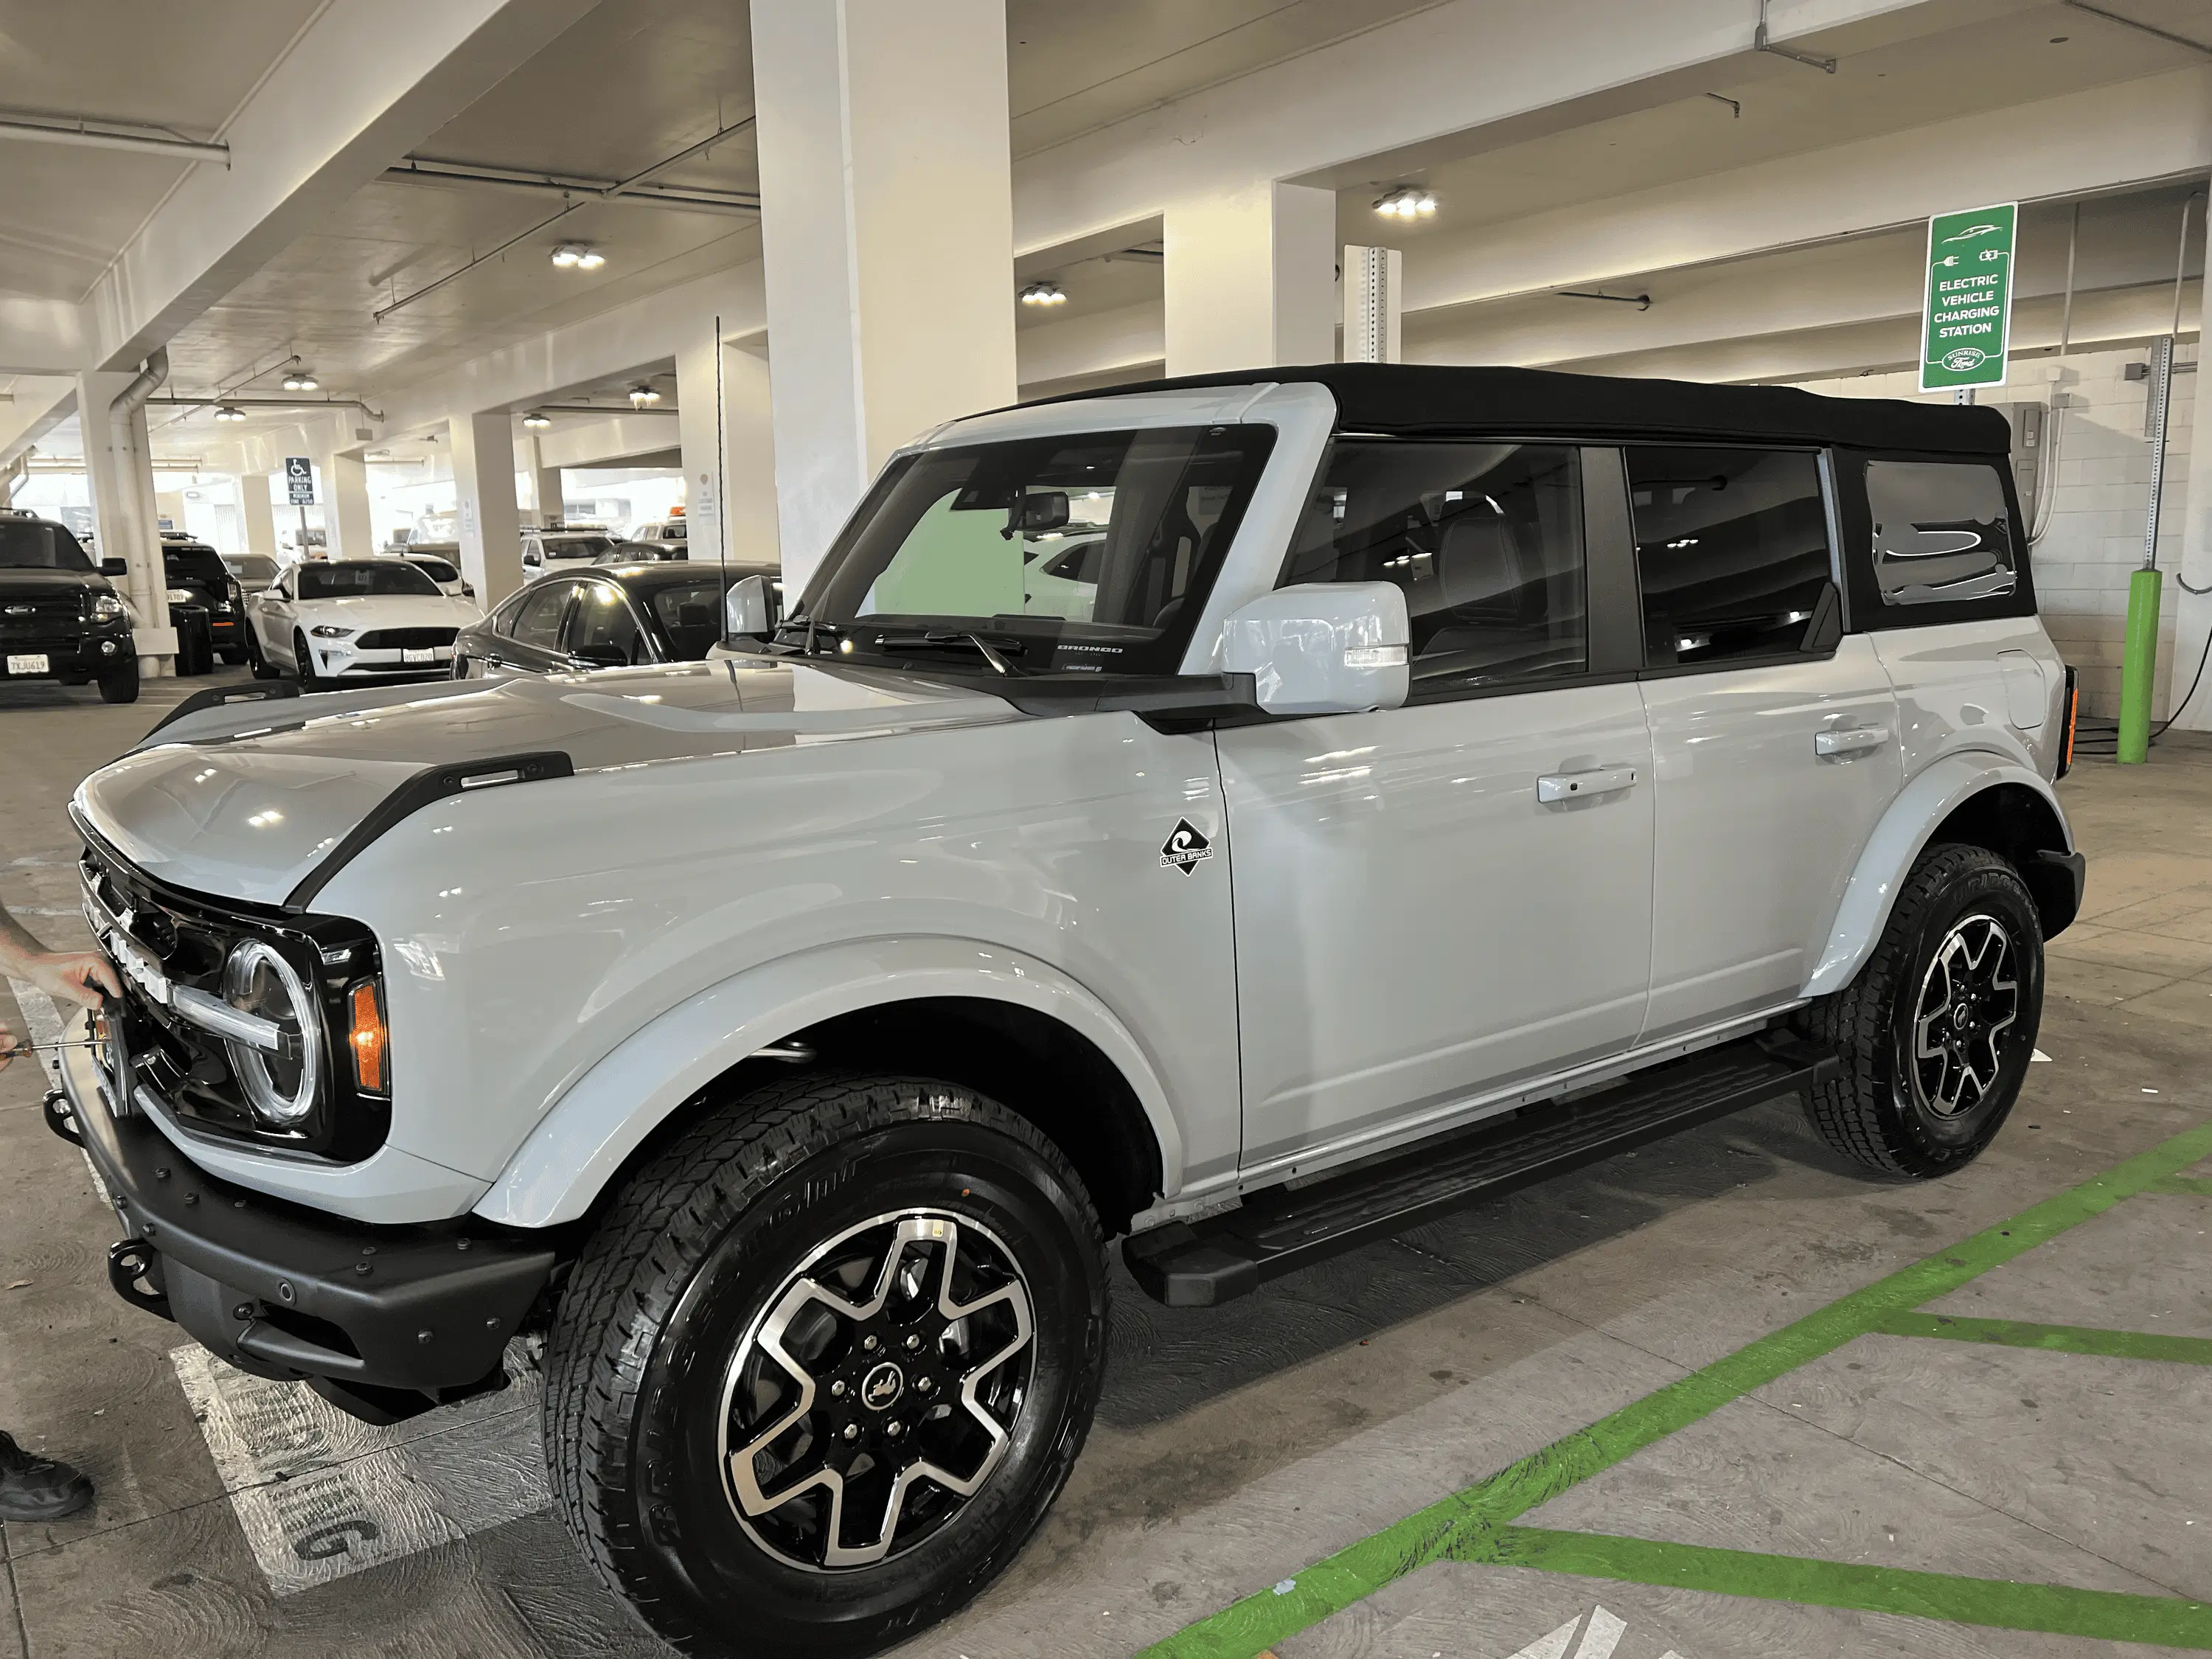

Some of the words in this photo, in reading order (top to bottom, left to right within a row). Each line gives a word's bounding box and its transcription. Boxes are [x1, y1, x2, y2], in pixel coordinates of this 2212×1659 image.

[1939, 274, 1999, 291] ELECTRIC
[1941, 291, 1994, 307] VEHICLE
[1934, 306, 2000, 323] CHARGING
[1939, 322, 1992, 338] STATION
[1947, 349, 1981, 361] SUNRISE
[1951, 357, 1975, 369] Ford
[288, 476, 311, 484] PARKING
[293, 484, 307, 492] ONLY
[1057, 644, 1123, 653] BRONCO
[11, 661, 45, 670] 7XJU619
[1162, 855, 1186, 865] OUTER
[1188, 849, 1211, 860] BANKS
